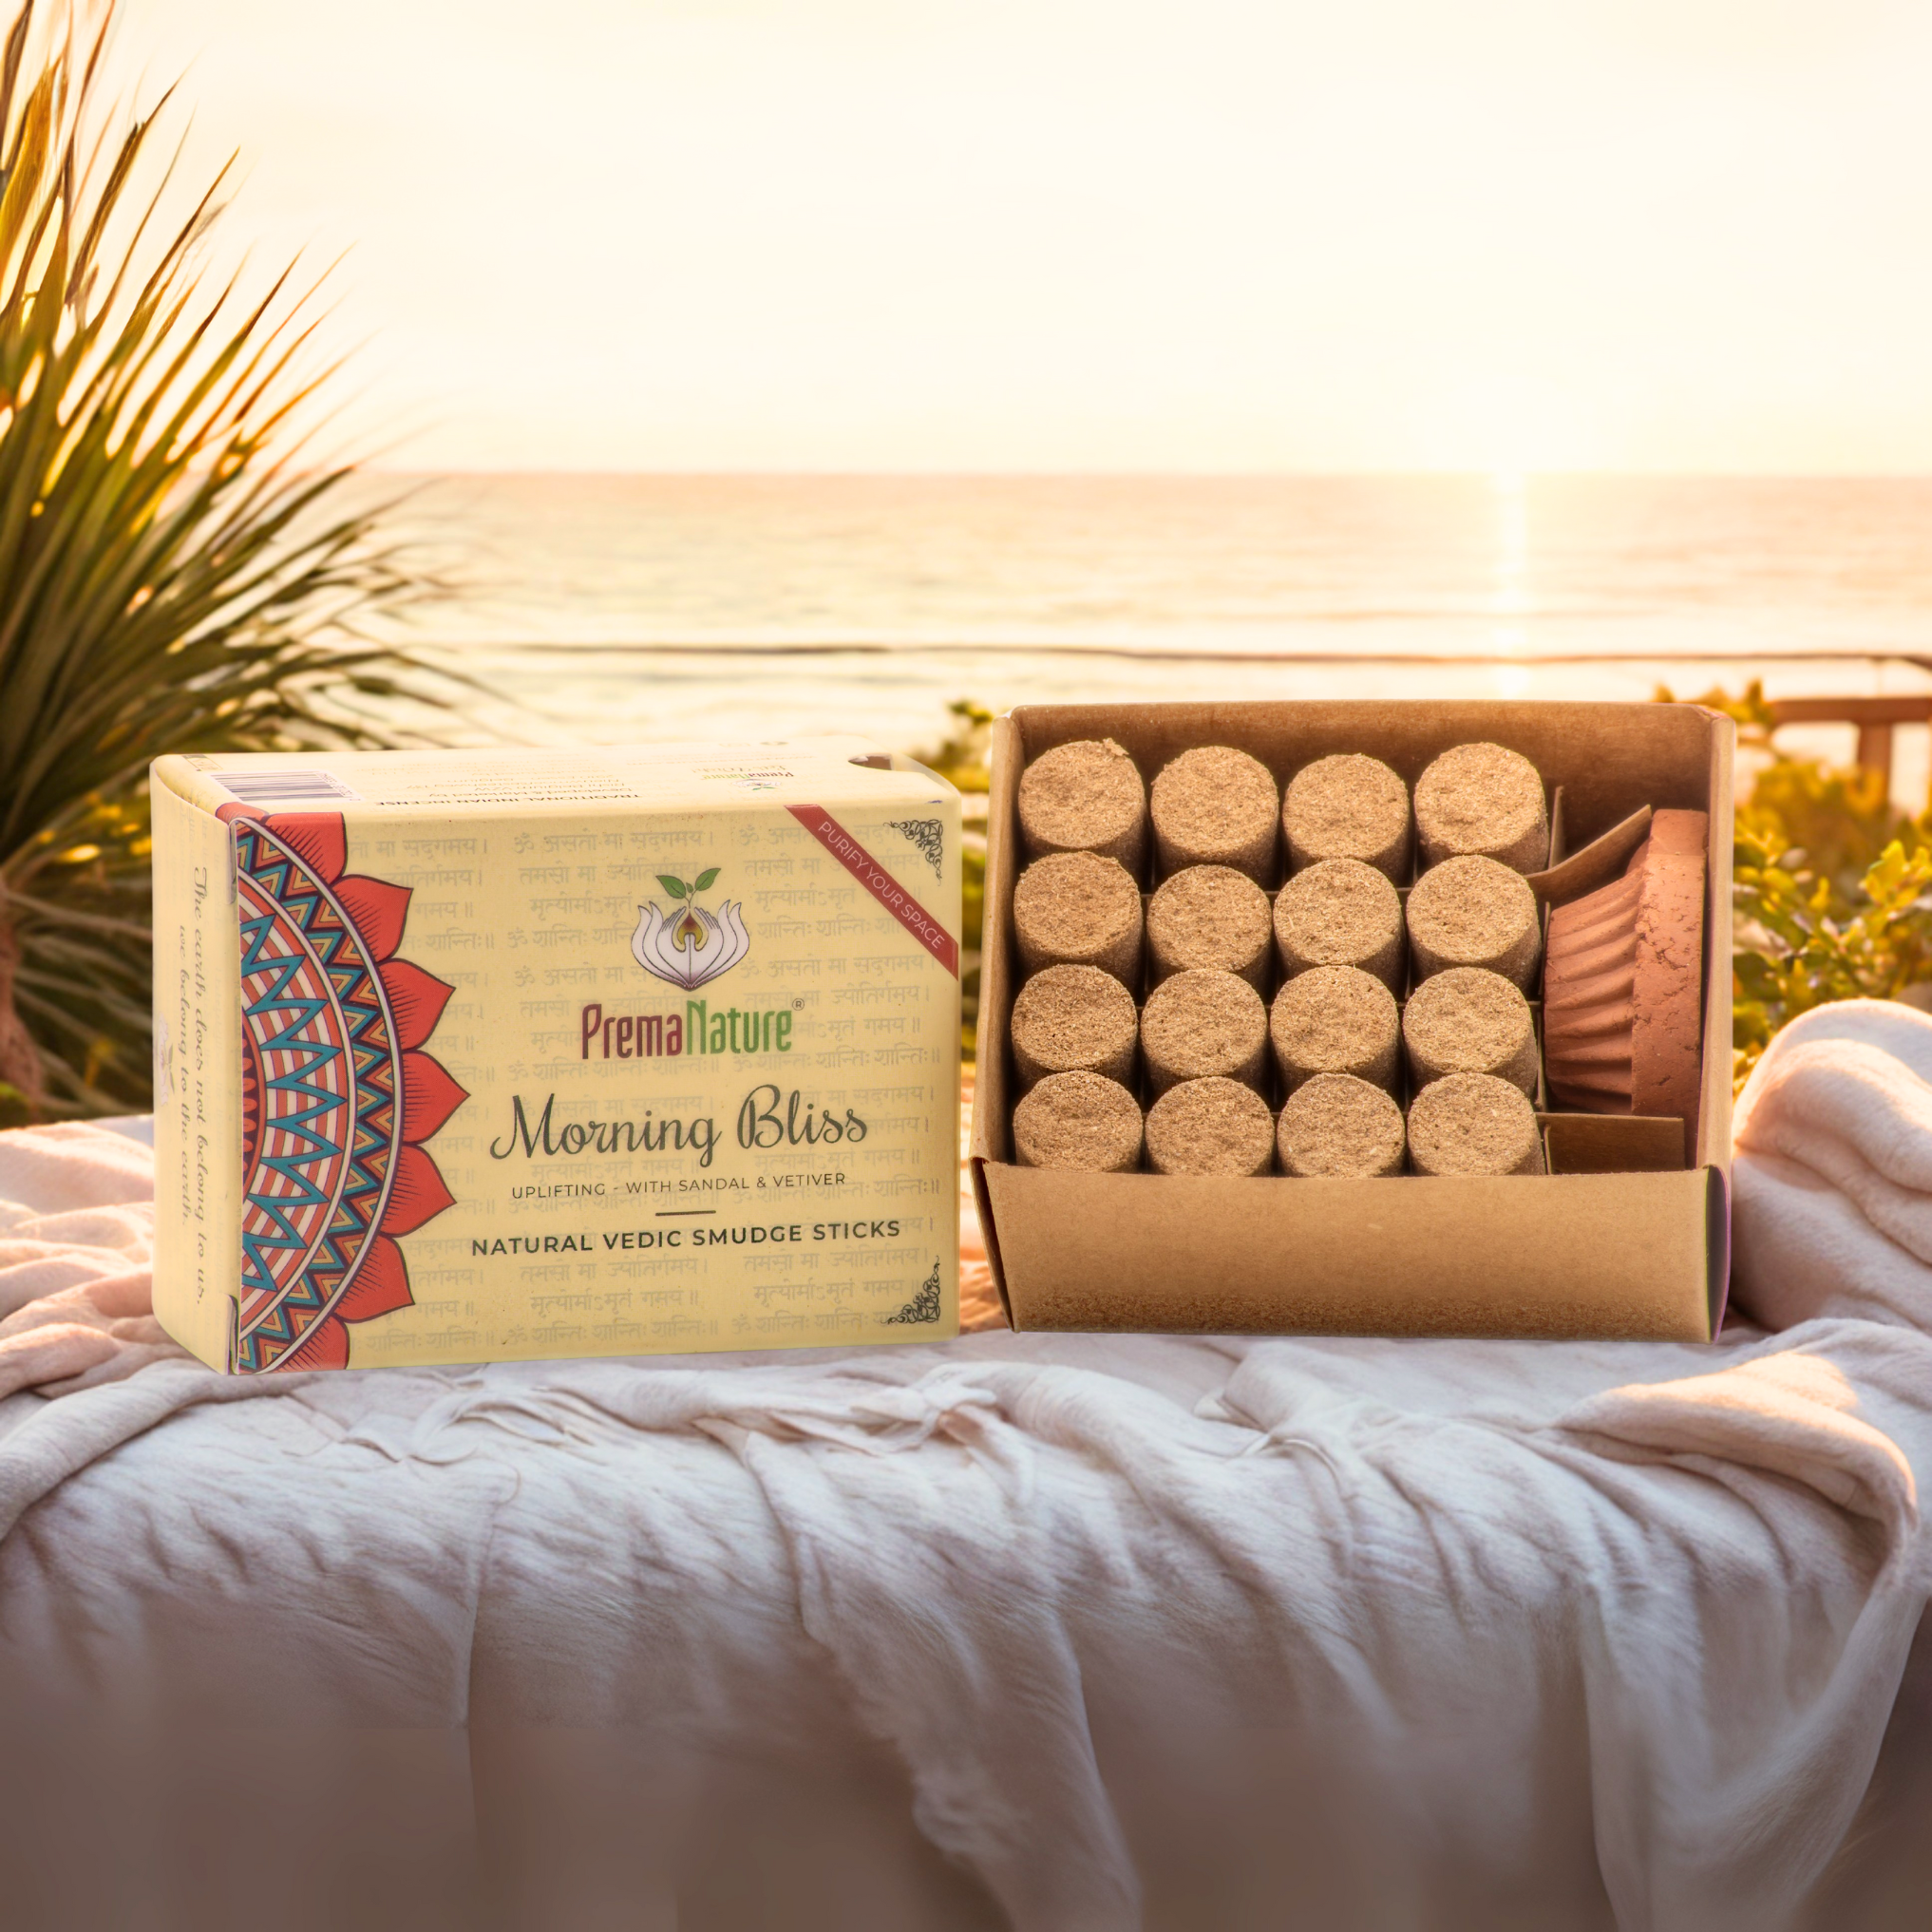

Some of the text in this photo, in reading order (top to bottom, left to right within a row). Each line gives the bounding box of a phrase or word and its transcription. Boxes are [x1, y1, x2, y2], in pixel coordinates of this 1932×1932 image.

[521, 794, 642, 803] TRADITIONAL
[194, 866, 208, 922] The
[818, 821, 869, 870] PURIFY
[865, 863, 904, 909] YOUR
[900, 904, 945, 949] SPACE
[180, 924, 187, 960] we
[195, 928, 206, 1000] earth
[178, 968, 190, 1061] belong
[195, 1008, 207, 1071] does
[180, 1067, 189, 1091] to
[196, 1079, 206, 1127] not
[180, 1102, 190, 1142] the
[489, 1084, 868, 1168] Morning Bliss
[194, 1134, 209, 1224] belong
[512, 1183, 606, 1199] UPLIFTING
[625, 1180, 672, 1195] WITH
[678, 1177, 750, 1192] SANDAL
[756, 1176, 767, 1188] &
[772, 1172, 846, 1187] VETIVER
[198, 1232, 207, 1260] to
[471, 1234, 593, 1256] NATURAL
[602, 1229, 682, 1251] VEDIC
[692, 1224, 803, 1246] SMUDGE
[812, 1220, 900, 1241] STICKS
